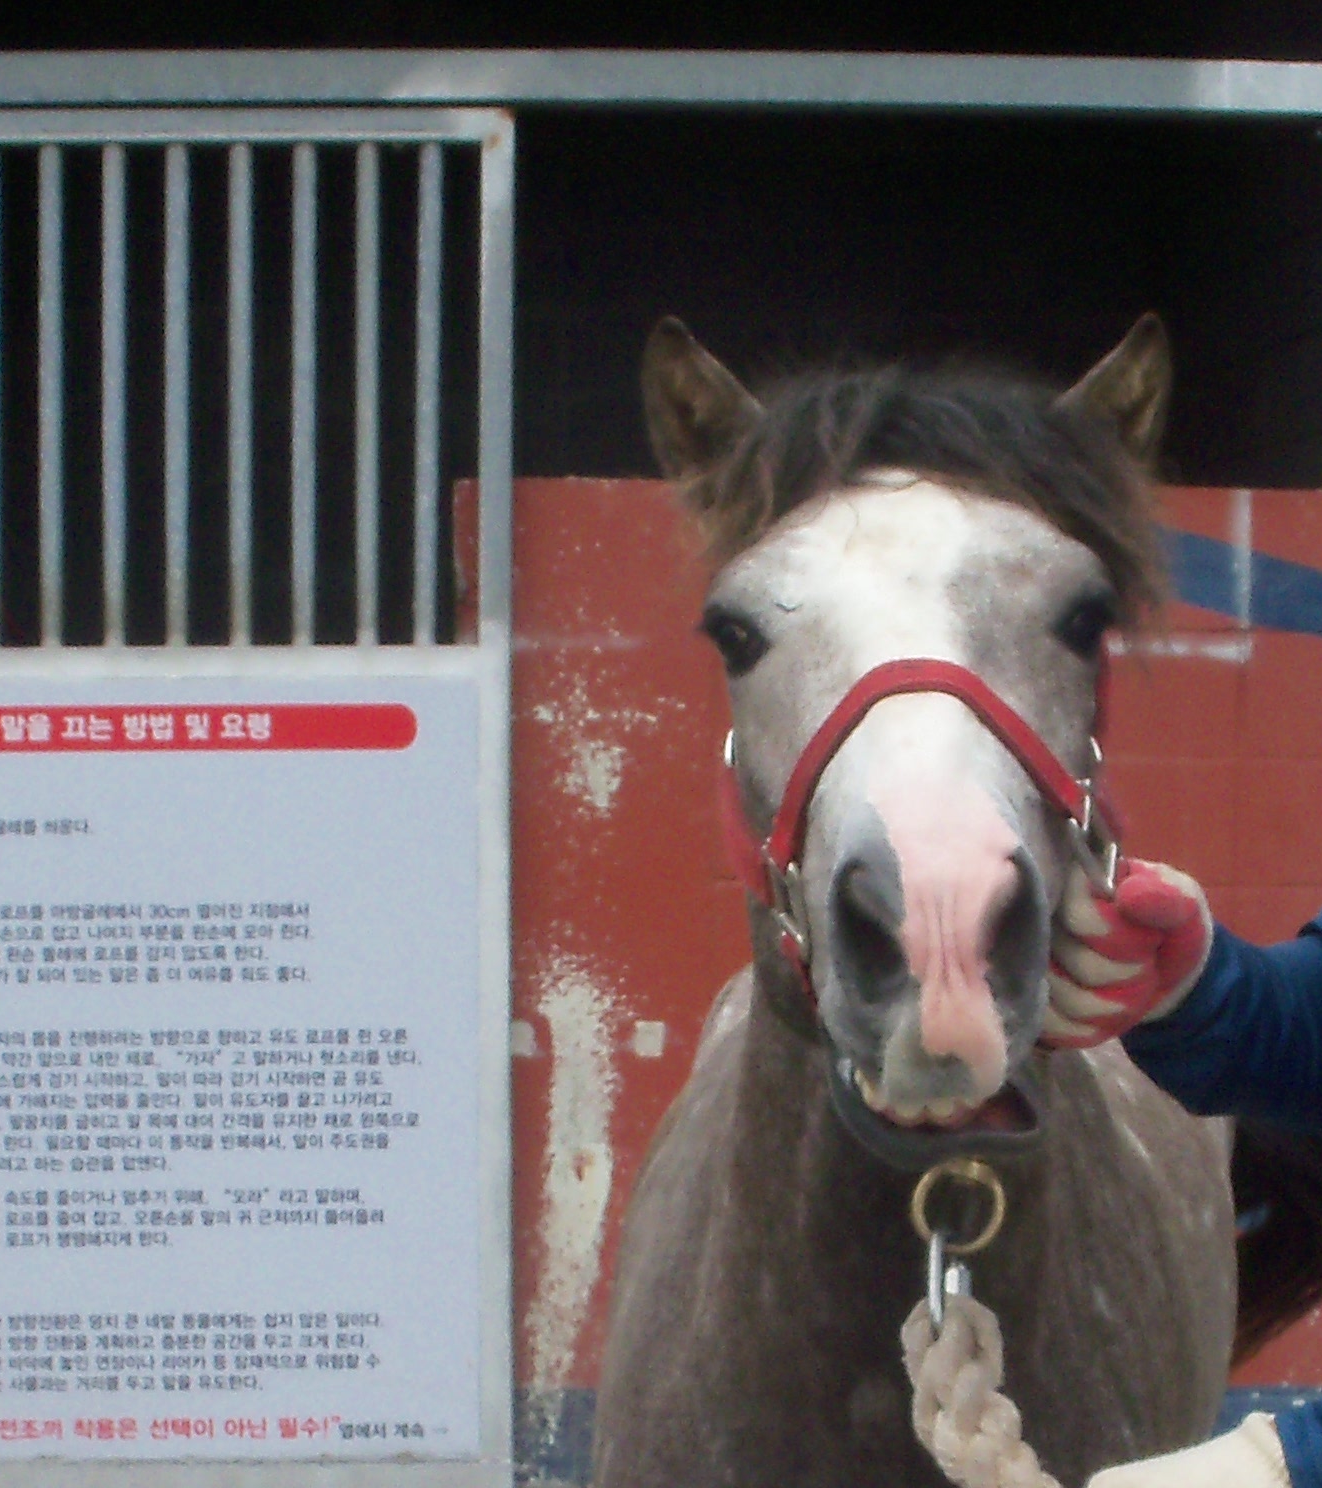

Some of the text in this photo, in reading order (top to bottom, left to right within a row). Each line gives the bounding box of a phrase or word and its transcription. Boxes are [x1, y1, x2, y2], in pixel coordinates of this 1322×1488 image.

[1, 714, 51, 741] 말을
[62, 713, 112, 740] 끄는
[123, 713, 173, 740] 방법
[185, 713, 209, 740] 및
[221, 713, 271, 740] 요령
[73, 1419, 137, 1439] 착용은
[149, 1418, 213, 1439] 선택이
[223, 1418, 267, 1439] 아닌
